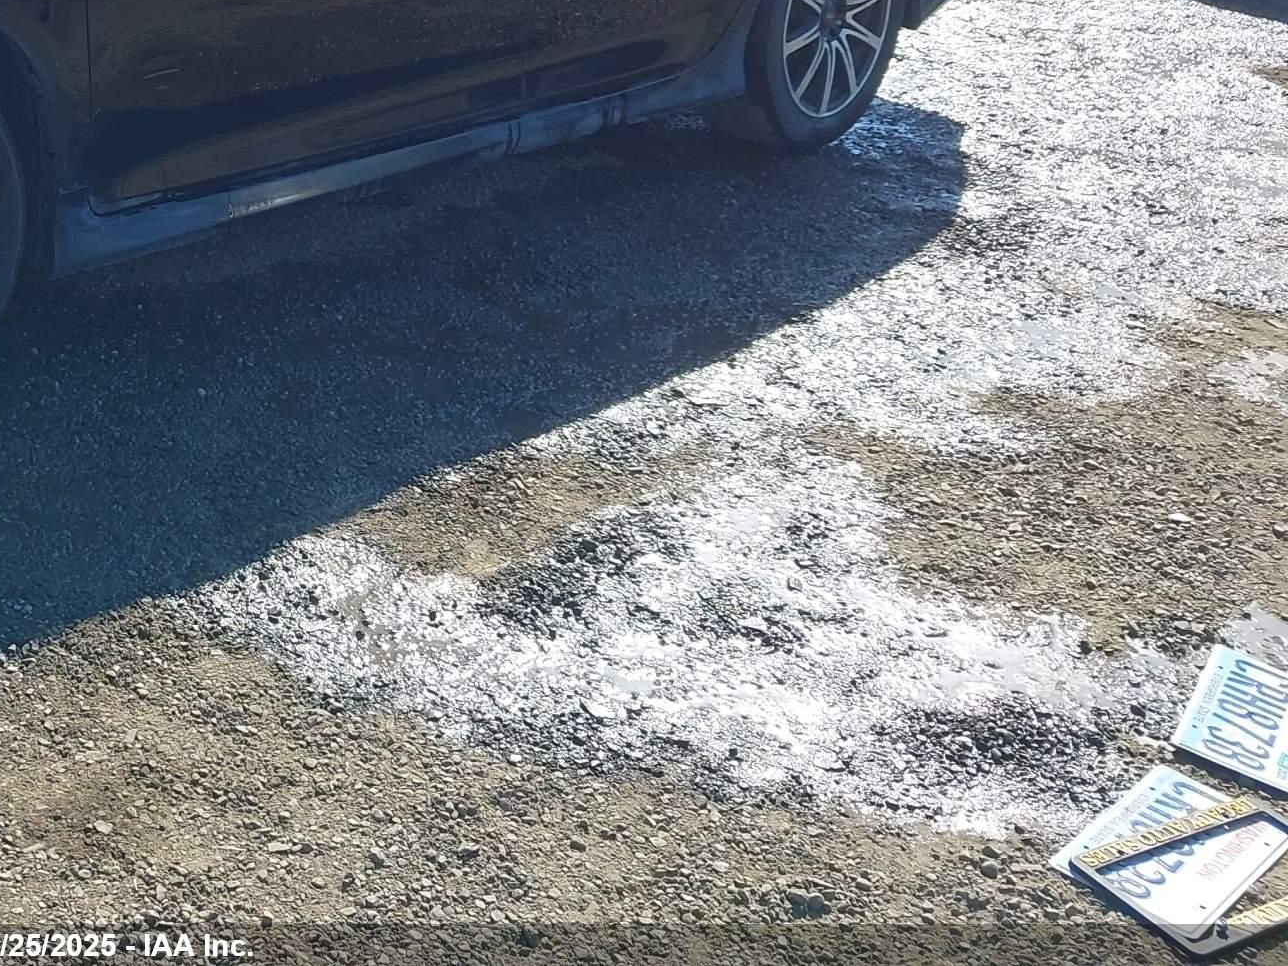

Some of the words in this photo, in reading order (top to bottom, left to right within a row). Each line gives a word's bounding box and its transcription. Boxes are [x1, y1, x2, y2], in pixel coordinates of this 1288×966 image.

[1185, 797, 1258, 830] LEGACY
[1138, 821, 1188, 847] AUTO
[1079, 838, 1142, 868] SALES
